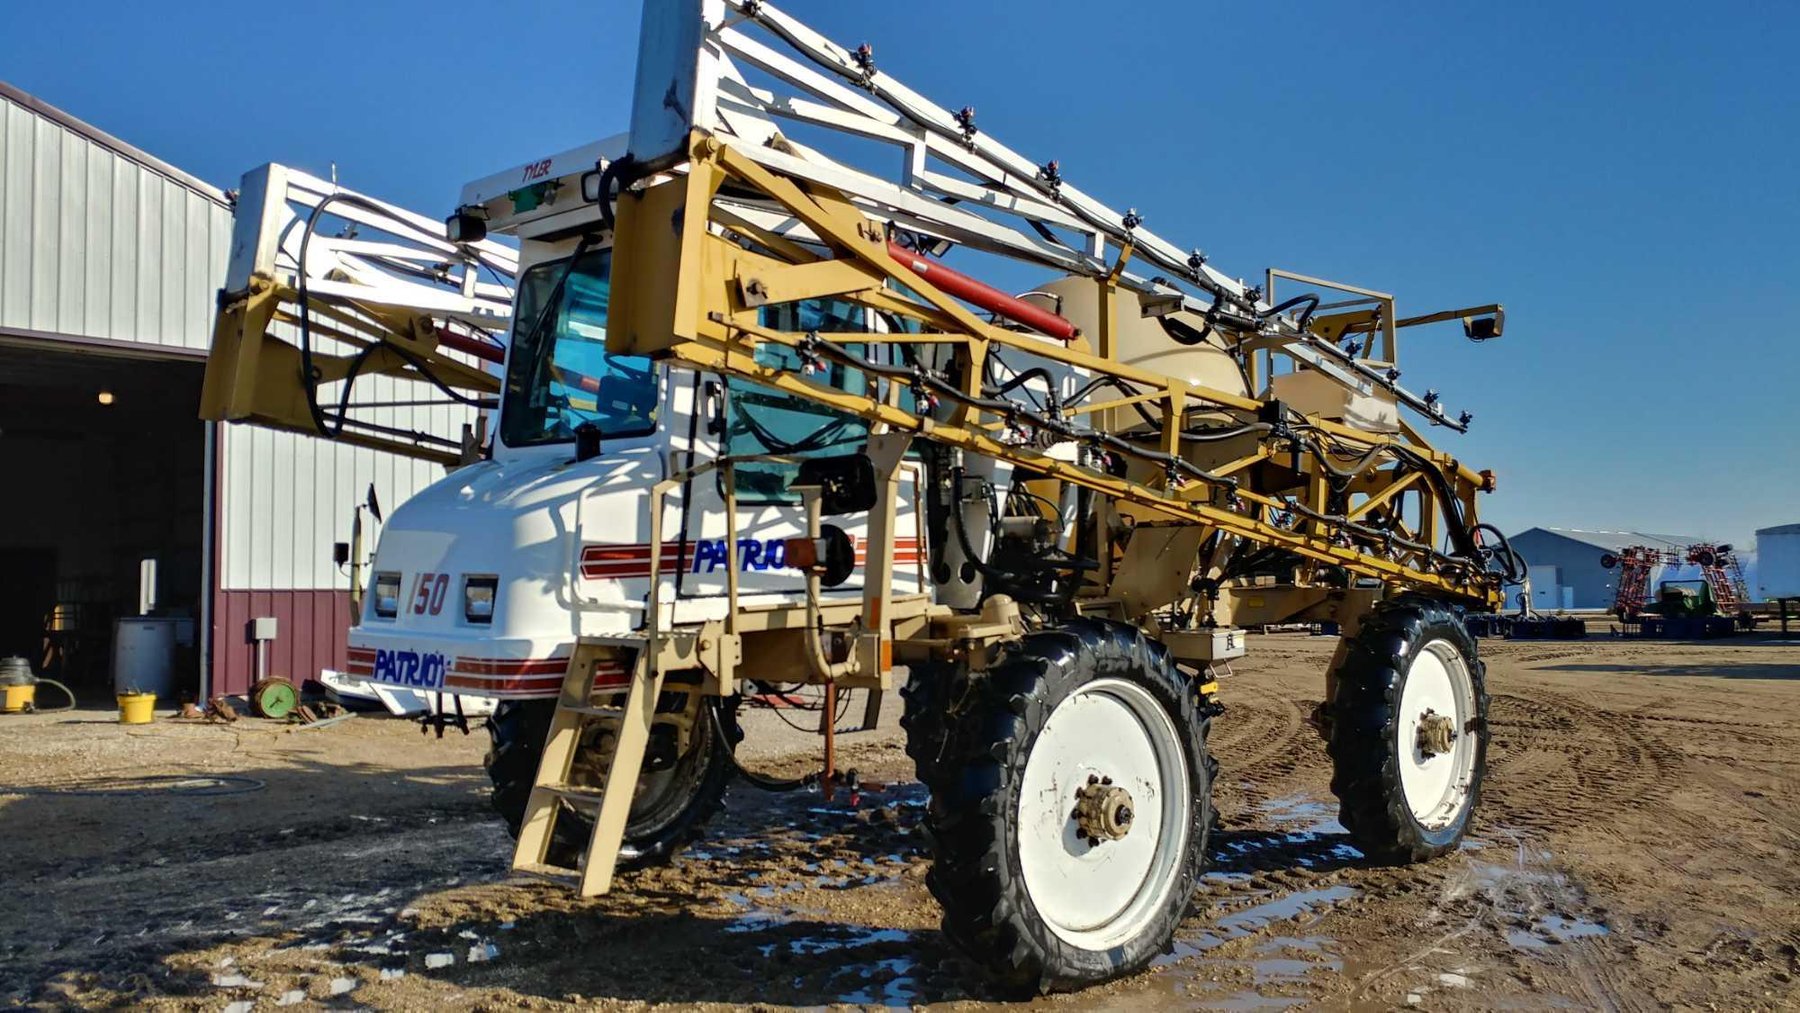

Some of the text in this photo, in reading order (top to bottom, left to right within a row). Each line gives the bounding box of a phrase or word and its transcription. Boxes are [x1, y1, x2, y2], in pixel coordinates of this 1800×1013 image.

[522, 159, 552, 182] TYLER
[692, 539, 785, 573] PARIO
[406, 573, 450, 616] 150
